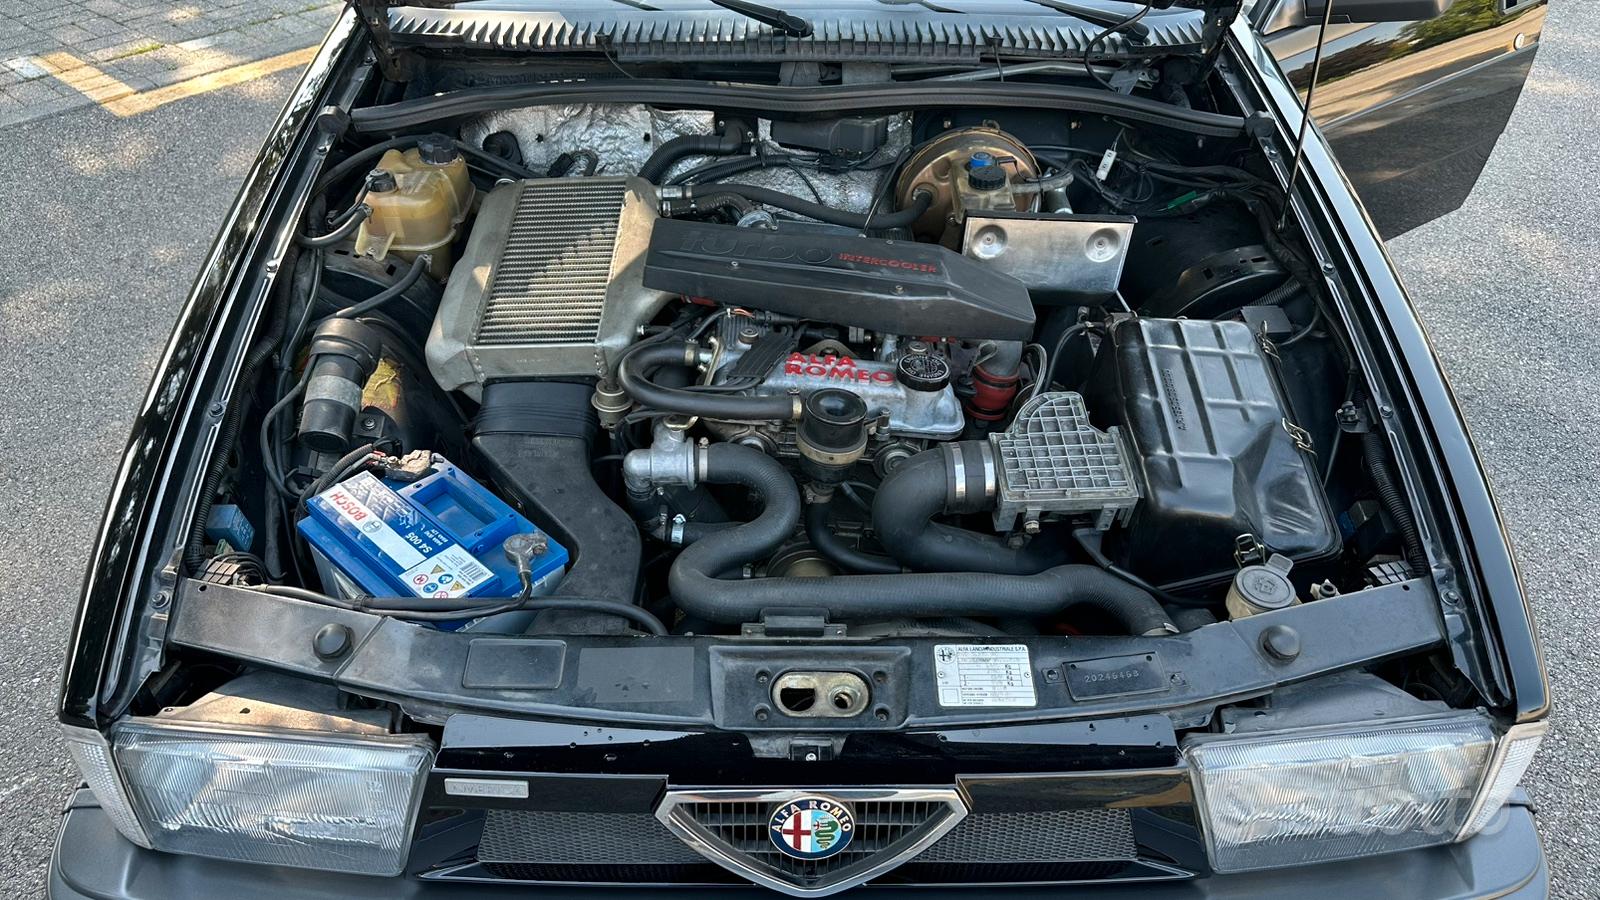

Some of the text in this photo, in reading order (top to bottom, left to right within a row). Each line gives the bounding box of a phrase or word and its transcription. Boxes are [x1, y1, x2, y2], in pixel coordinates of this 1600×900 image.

[838, 252, 937, 273] INTERCOOLER
[785, 351, 857, 369] ALFA
[784, 363, 897, 386] ROMEO
[330, 491, 368, 521] BOSCH
[405, 532, 422, 545] 005
[772, 800, 852, 833] ALFA ROMEO
